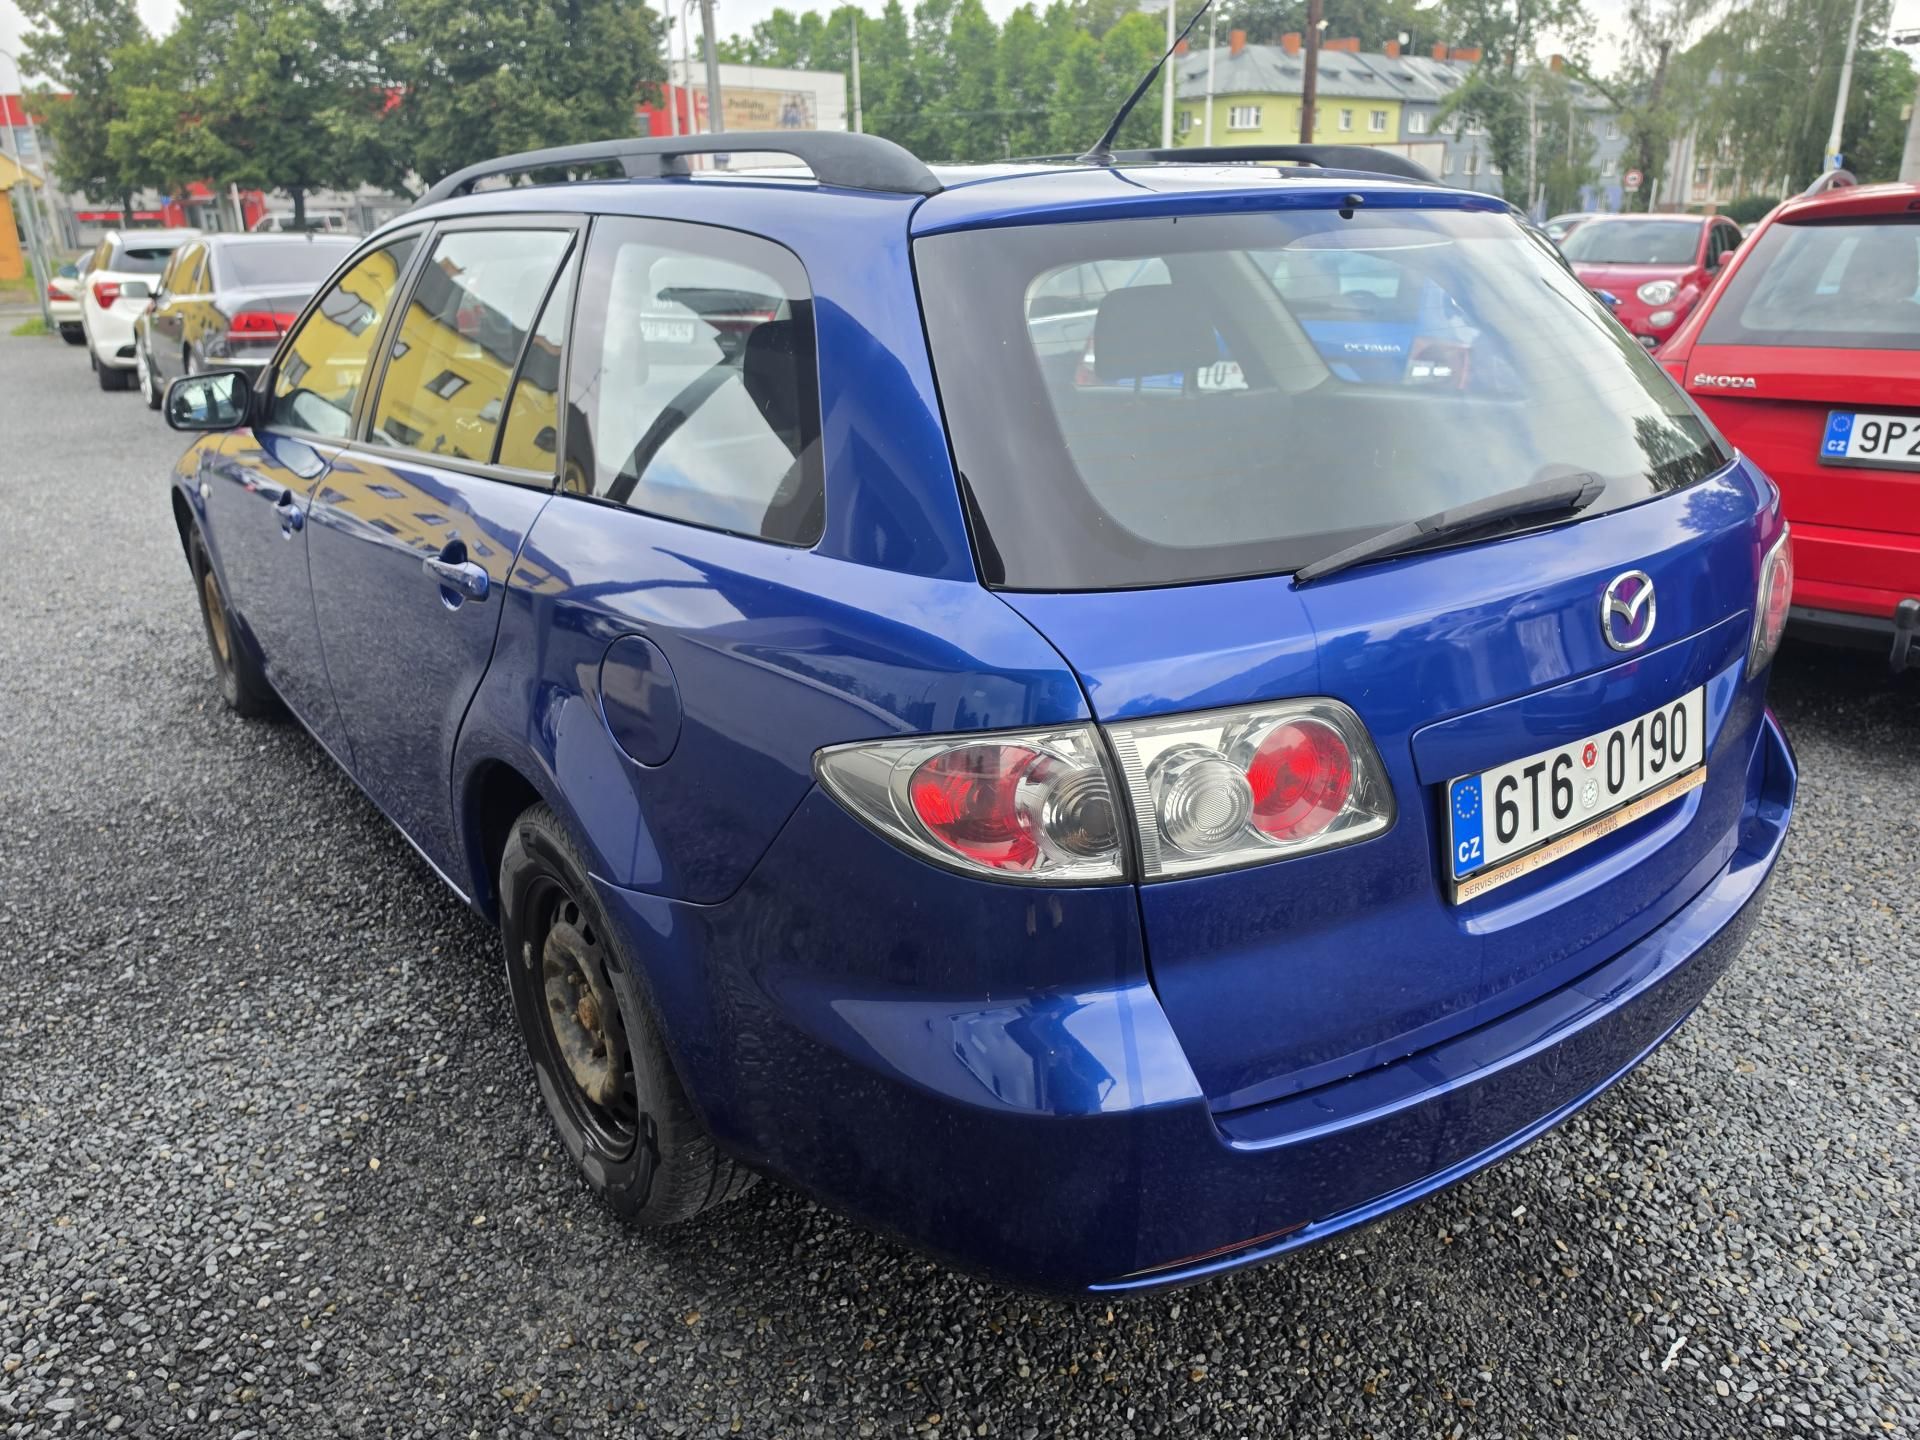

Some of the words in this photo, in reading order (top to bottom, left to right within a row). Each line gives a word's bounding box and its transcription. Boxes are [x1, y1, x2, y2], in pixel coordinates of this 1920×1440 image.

[1694, 372, 1757, 389] ŠKODA
[1827, 440, 1847, 452] CZ
[1494, 752, 1574, 844] 6T6
[1606, 701, 1688, 795] 0190
[1458, 836, 1481, 863] CZ
